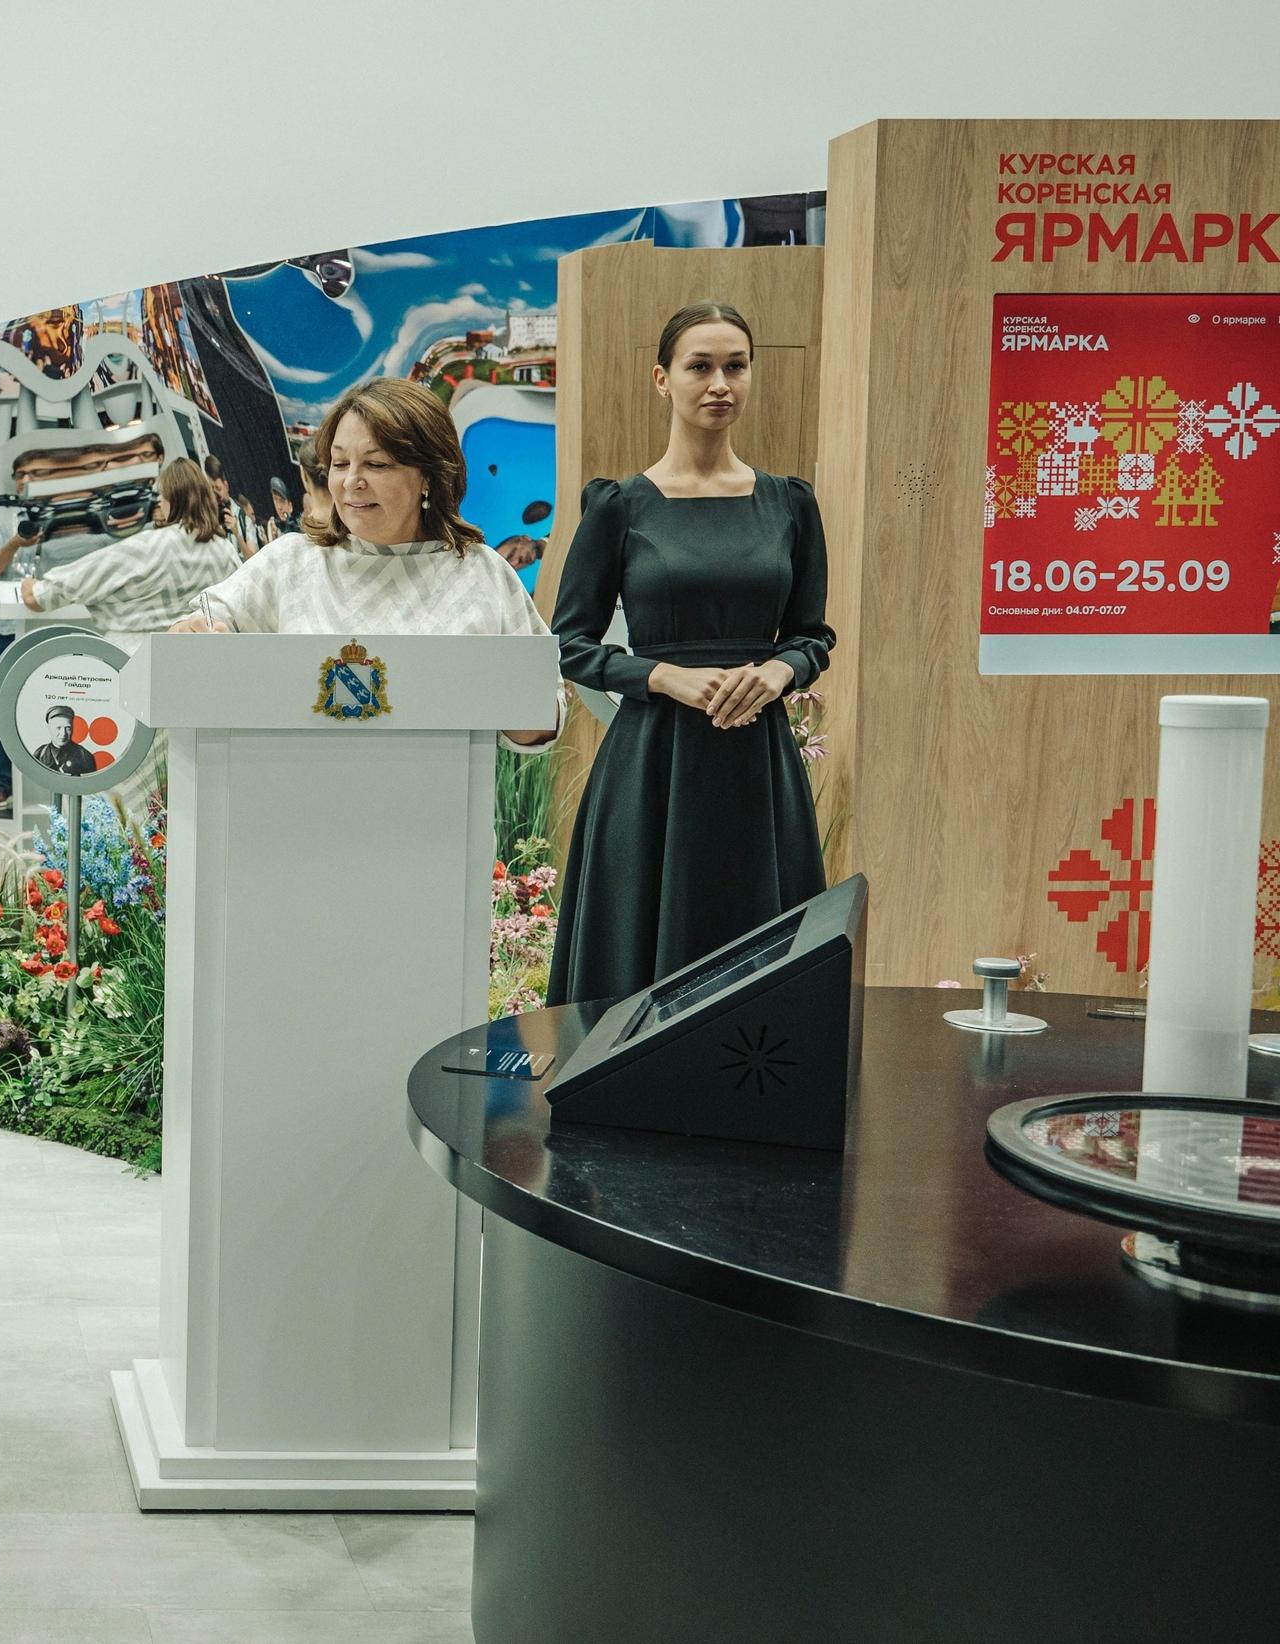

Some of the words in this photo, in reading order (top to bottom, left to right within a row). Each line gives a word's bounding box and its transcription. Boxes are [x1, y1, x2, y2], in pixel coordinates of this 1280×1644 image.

[998, 153, 1136, 175] КУРСКАЯ
[997, 183, 1171, 204] КОРЕНСКАЯ
[1002, 316, 1047, 324] КУРСКАЯ
[1212, 314, 1221, 325] О
[1222, 316, 1267, 326] ярмарке
[1002, 325, 1059, 333] КОРЕНСКАЯ
[1000, 334, 1109, 351] ЯРМАРКА
[990, 560, 1230, 592] 18.06-25.09
[988, 605, 1040, 616] Основные
[1041, 606, 1064, 617] дни:
[1065, 605, 1127, 615] 04.07-07.07
